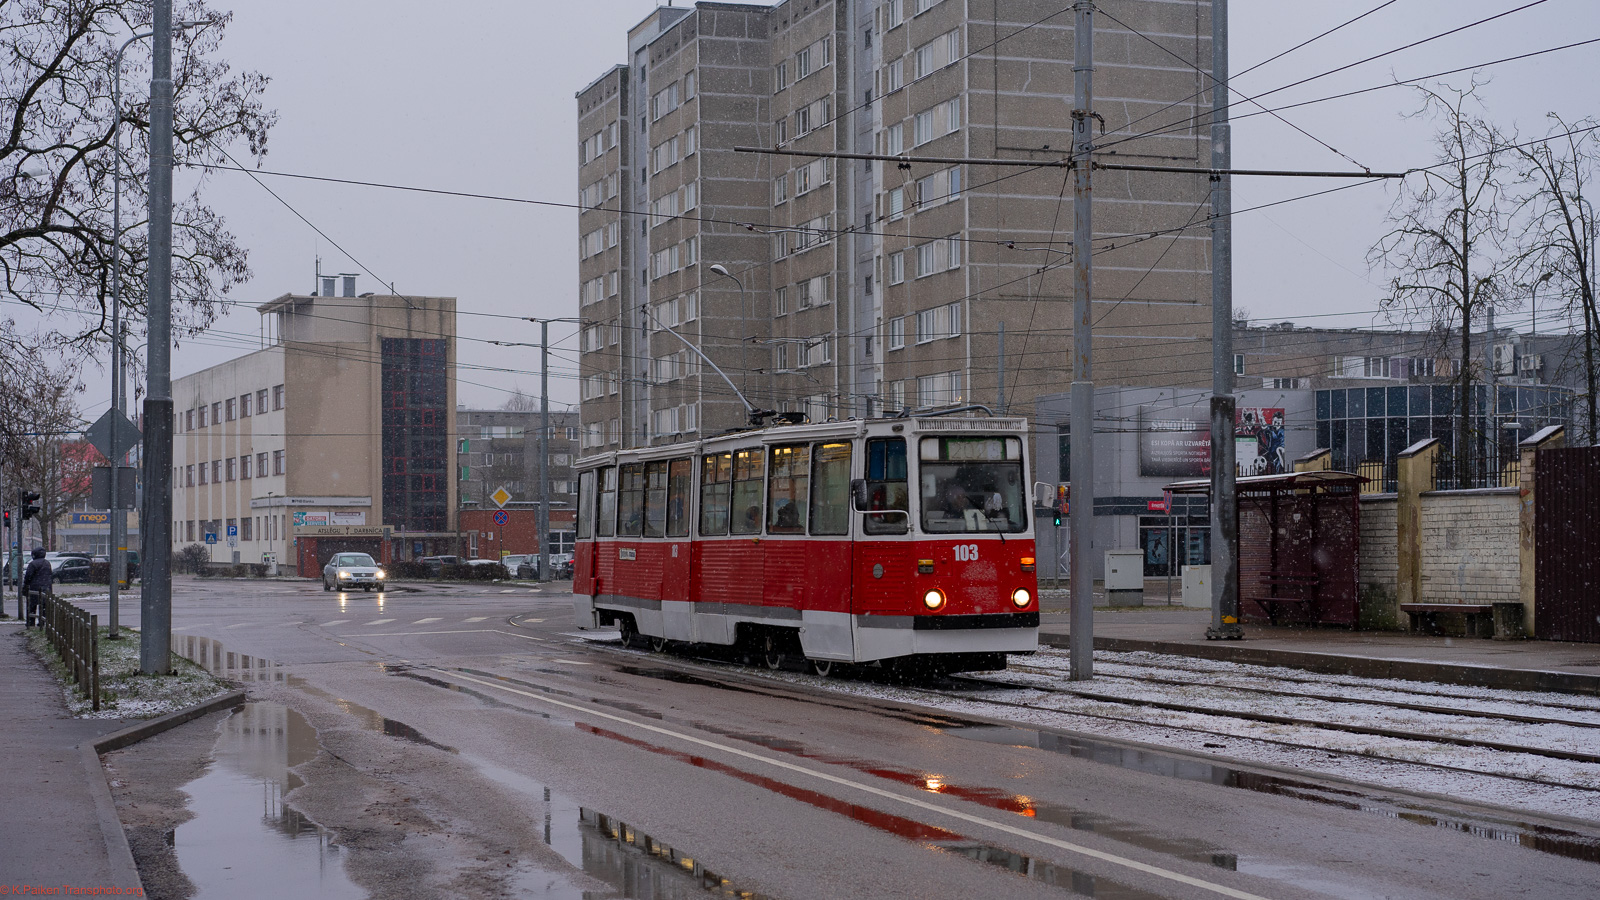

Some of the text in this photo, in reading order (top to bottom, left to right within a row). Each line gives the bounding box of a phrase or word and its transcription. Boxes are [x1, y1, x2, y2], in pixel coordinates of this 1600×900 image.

[1161, 439, 1175, 447] KOPĀ
[79, 514, 107, 523] mego
[971, 512, 979, 530] 1
[229, 526, 235, 535] P
[952, 543, 979, 562] 103
